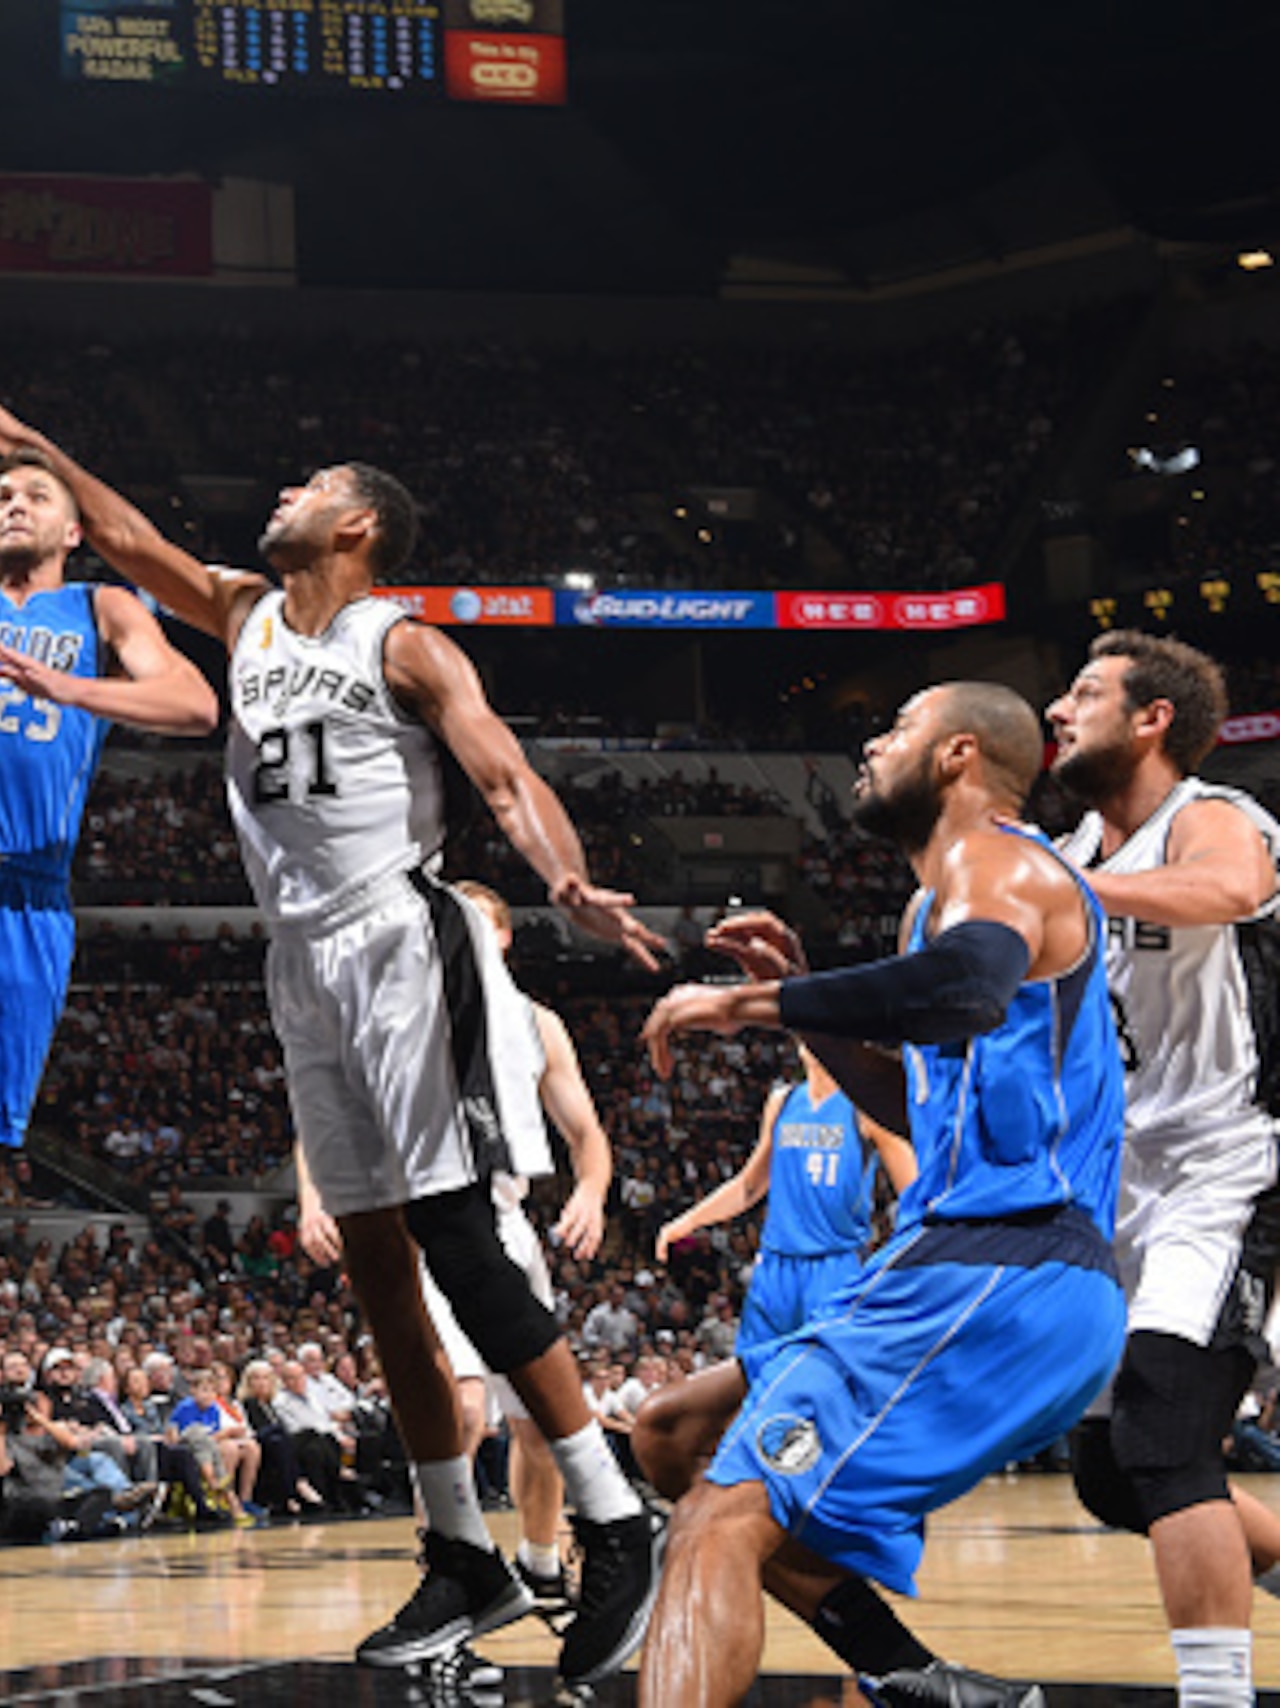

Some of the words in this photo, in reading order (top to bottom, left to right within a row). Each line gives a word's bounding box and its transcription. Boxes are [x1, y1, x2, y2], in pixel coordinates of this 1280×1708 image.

[65, 33, 183, 63] POWERFUL
[591, 595, 657, 619] BUD
[658, 597, 753, 620] LIGHT
[242, 665, 376, 712] SPURS
[256, 721, 337, 803] 21
[778, 1123, 845, 1150] DALLAS
[806, 1152, 841, 1187] 41
